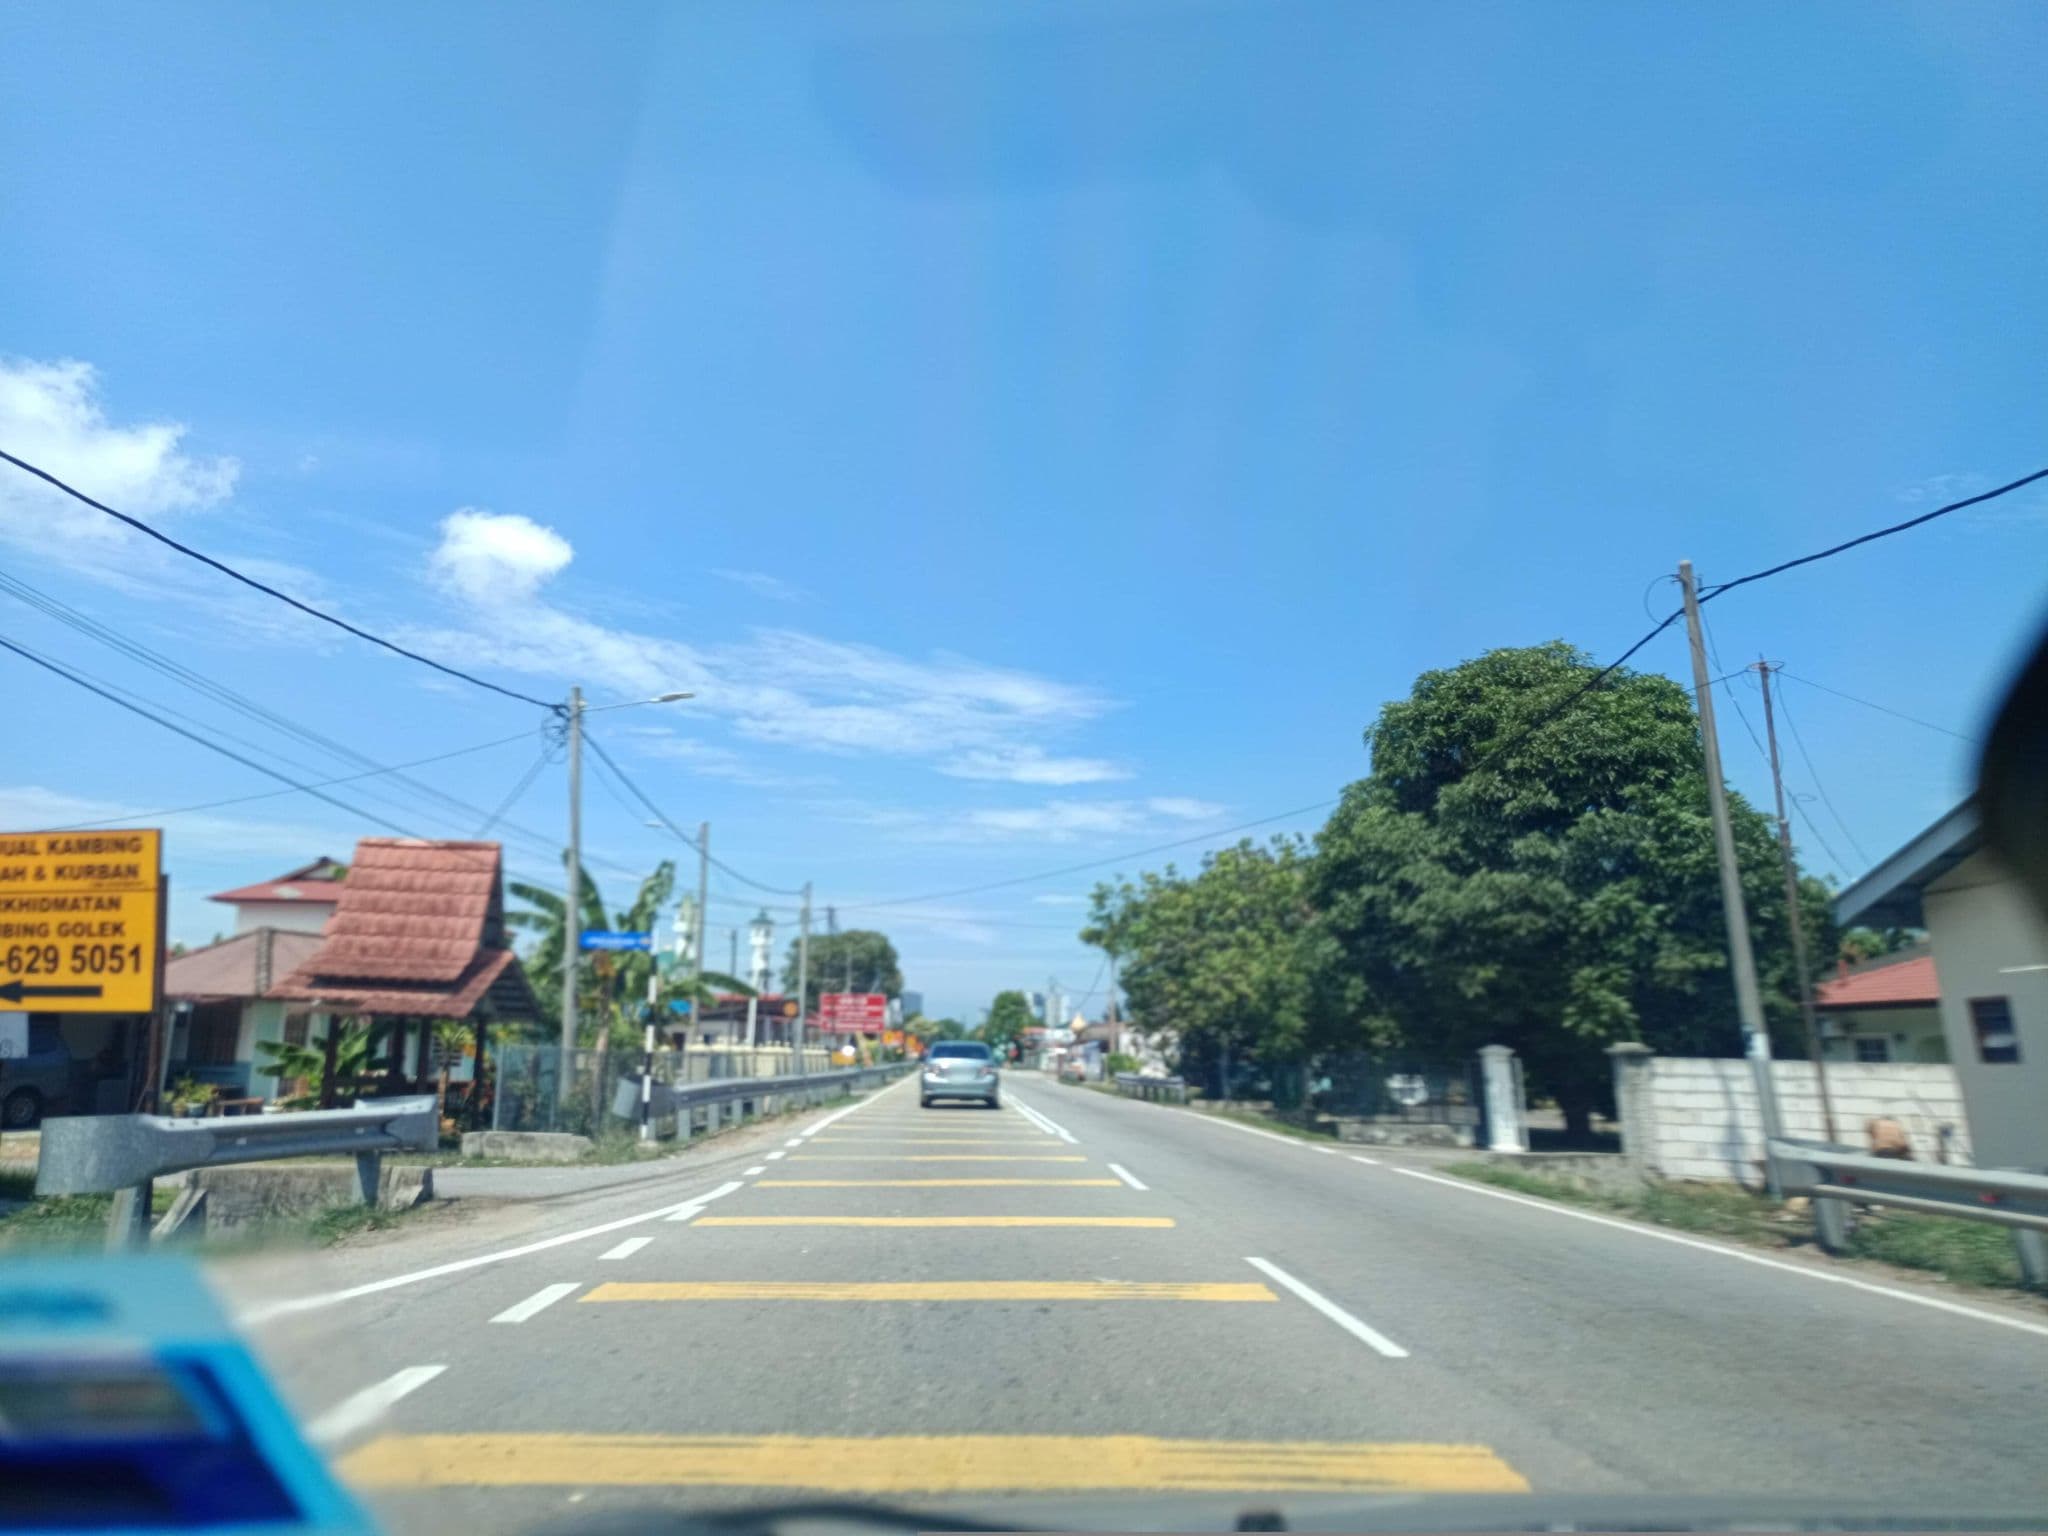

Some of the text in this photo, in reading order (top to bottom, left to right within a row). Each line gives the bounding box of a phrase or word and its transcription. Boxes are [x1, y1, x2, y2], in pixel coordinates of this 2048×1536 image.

[48, 837, 143, 854] KAMBING
[34, 866, 46, 880] &
[54, 864, 139, 880] KURBAN
[57, 921, 125, 937] GOLEK
[71, 944, 141, 974] 5051
